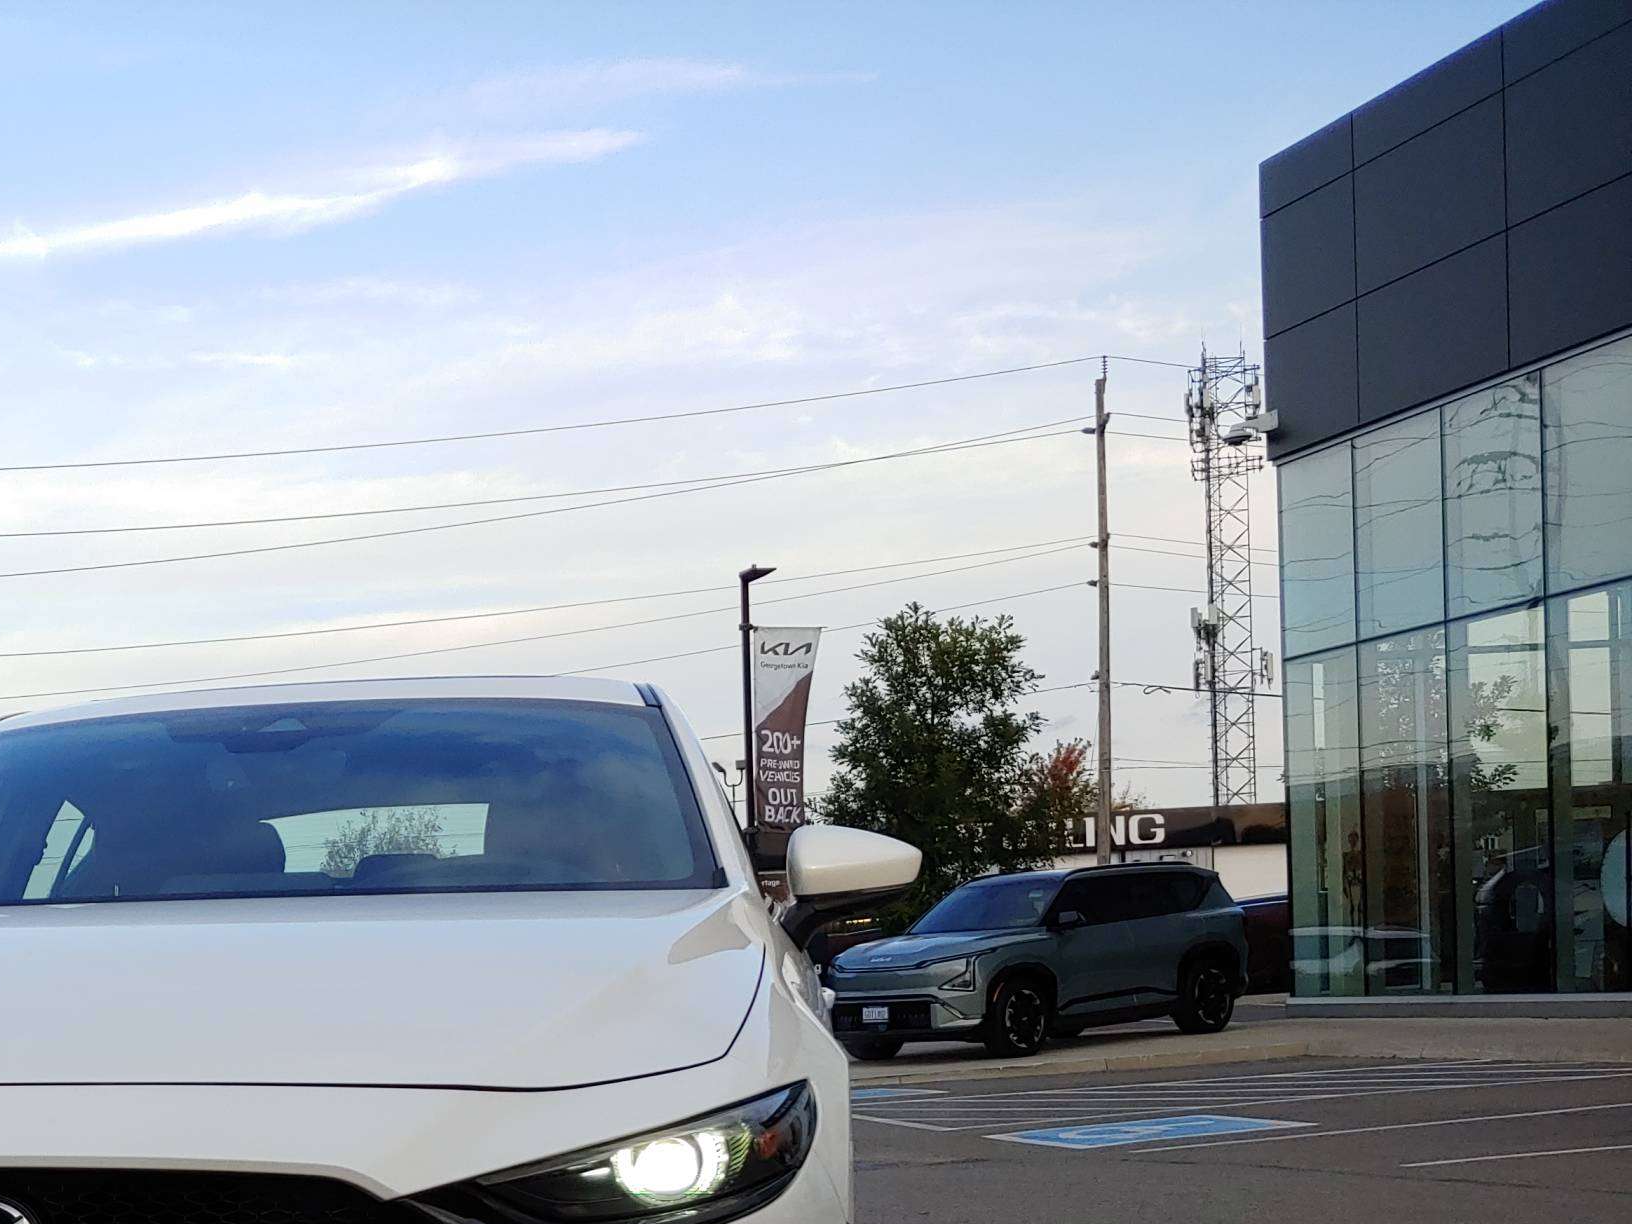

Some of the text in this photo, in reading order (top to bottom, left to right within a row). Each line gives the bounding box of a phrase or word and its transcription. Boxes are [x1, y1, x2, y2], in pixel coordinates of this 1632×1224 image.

[760, 641, 812, 656] KIA
[760, 729, 801, 754] 200+
[768, 787, 797, 806] OUT
[764, 805, 801, 824] BACK
